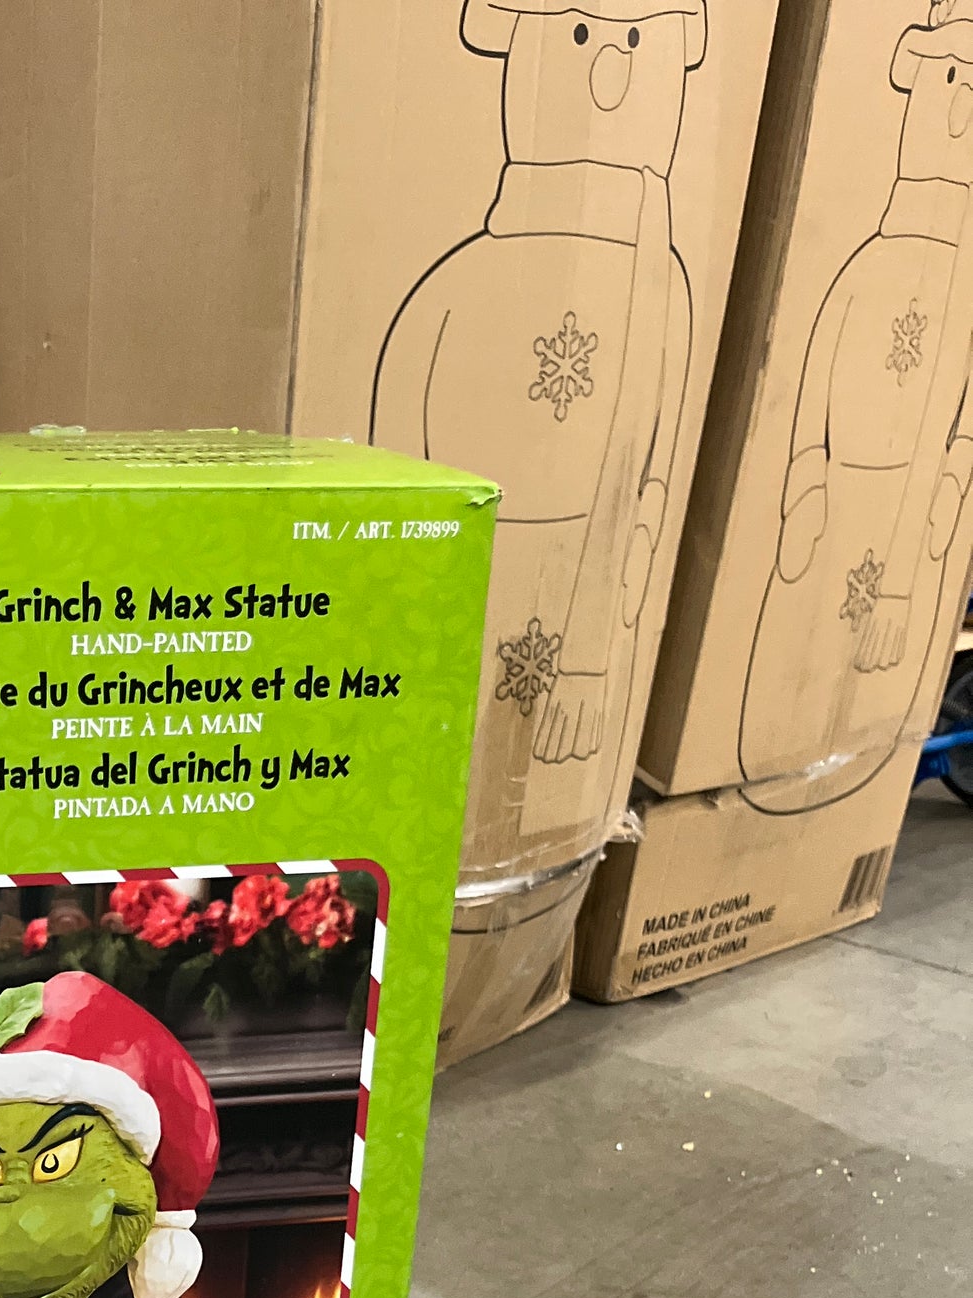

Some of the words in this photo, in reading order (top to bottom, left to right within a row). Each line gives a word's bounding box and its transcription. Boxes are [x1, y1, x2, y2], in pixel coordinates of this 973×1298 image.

[293, 521, 331, 540] ITM.
[337, 521, 350, 541] /
[354, 521, 395, 540] ART.
[401, 520, 460, 540] 1739899
[114, 586, 137, 622] &
[148, 585, 214, 621] Max
[224, 583, 331, 619] Statue
[71, 631, 252, 656] HAND-PAINTED
[28, 671, 68, 709] du
[77, 663, 243, 706] Grincheux
[251, 667, 285, 701] et
[294, 665, 331, 701] de
[339, 665, 402, 700] Max
[51, 716, 134, 740] PEINTE
[140, 712, 156, 738] À
[163, 715, 193, 737] LA
[201, 712, 264, 735] MAIN
[91, 751, 138, 788] del
[148, 744, 252, 785] Grinch
[260, 756, 281, 790] y
[289, 748, 351, 781] Max
[53, 796, 152, 820] PINTADA
[159, 795, 175, 815] A
[182, 792, 255, 815] MANO
[642, 910, 690, 937] MADE
[691, 905, 708, 925] IN
[708, 892, 751, 920] CHINA
[712, 919, 733, 939] EN
[734, 904, 777, 932] CHINE
[631, 957, 683, 985] HECHO
[685, 949, 708, 969] EN
[707, 935, 748, 963] CHINA
